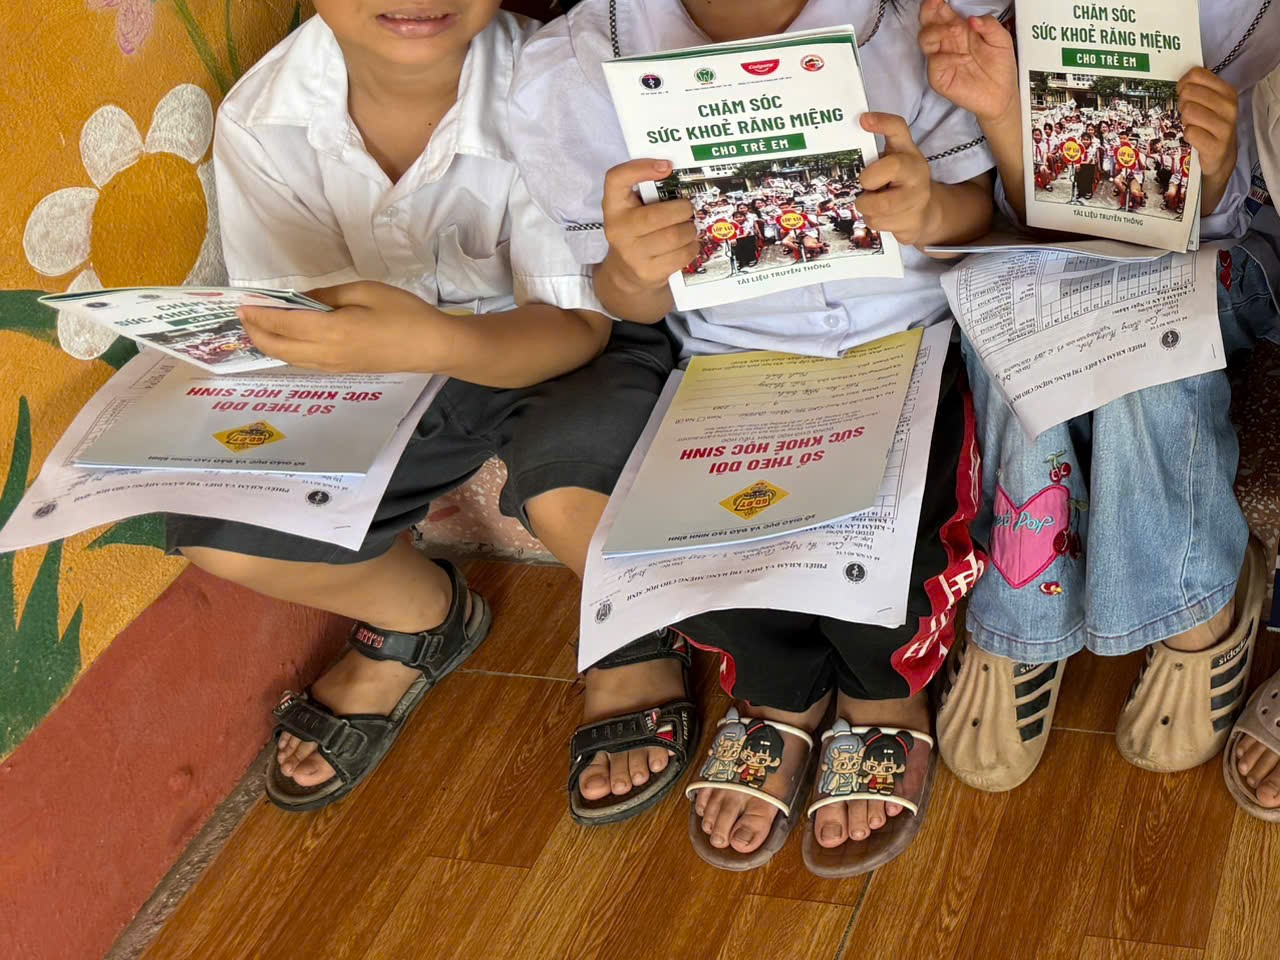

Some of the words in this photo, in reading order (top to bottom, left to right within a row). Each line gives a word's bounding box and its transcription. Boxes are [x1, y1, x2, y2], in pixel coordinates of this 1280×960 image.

[1073, 3, 1108, 21] CHĂM
[1112, 5, 1136, 23] SÓC
[1032, 22, 1056, 40] SỨC
[1061, 24, 1096, 43] KHOẺ
[1100, 28, 1136, 46] RĂNG
[1140, 31, 1180, 53] MIỆNG
[1077, 54, 1096, 64] CHO
[1100, 53, 1119, 66] TRẺ
[1124, 57, 1137, 67] EM
[698, 99, 745, 117] CHĂM
[749, 94, 783, 112] SÓC
[647, 126, 682, 143] SỨC
[687, 119, 734, 140] KHOẺ
[738, 115, 785, 134] RĂNG
[790, 107, 844, 130] MIỆNG
[711, 145, 737, 156] CHO
[741, 139, 767, 152] TRẺ
[772, 139, 789, 149] EM
[186, 387, 237, 397] SINH
[240, 388, 282, 398] HỌC
[342, 391, 382, 402] SỨC
[252, 402, 301, 413] THEO
[828, 427, 865, 443] SỨC
[731, 441, 769, 455] HỌC
[775, 435, 823, 455] KHOẺ
[680, 446, 726, 460] SINH
[796, 450, 824, 468] SỔ
[709, 460, 742, 475] DÕI
[747, 456, 792, 470] THEO
